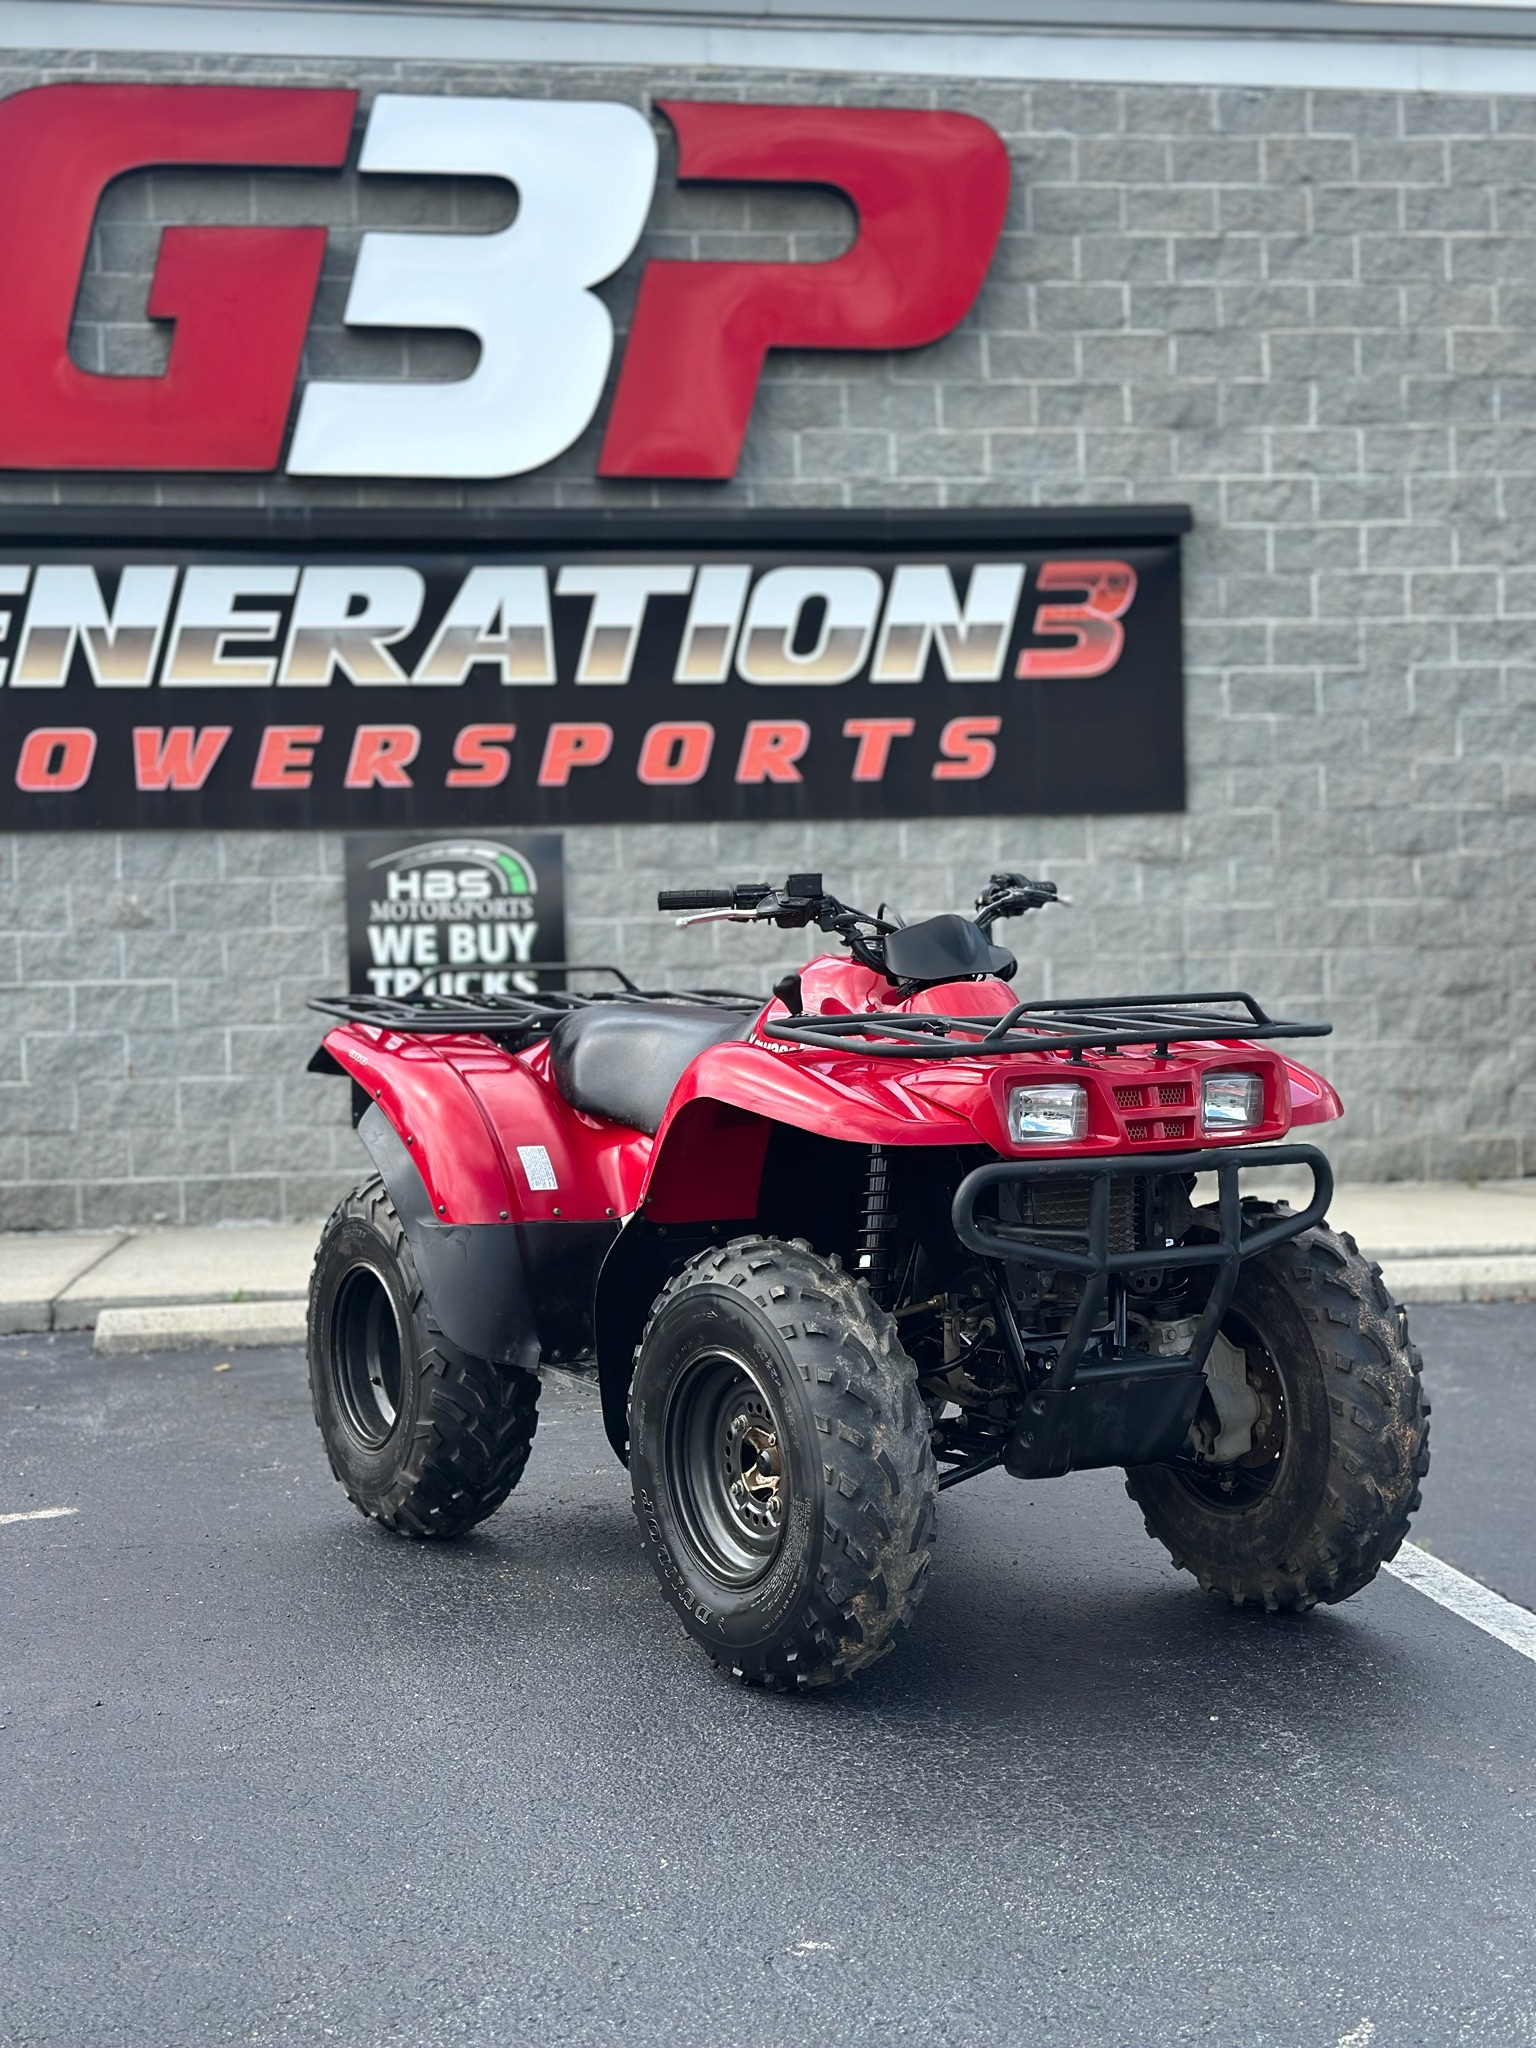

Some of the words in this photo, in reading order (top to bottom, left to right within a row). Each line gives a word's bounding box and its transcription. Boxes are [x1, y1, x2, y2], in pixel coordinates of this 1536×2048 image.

[0, 81, 1011, 480] G3P
[0, 563, 1027, 688] NERATION
[1014, 560, 1138, 680] 3
[15, 717, 1002, 791] OWERSPORTS
[369, 897, 534, 922] MOTORSPORTS
[386, 869, 492, 900] HBS
[366, 924, 438, 966] WE
[449, 921, 540, 963] BUY
